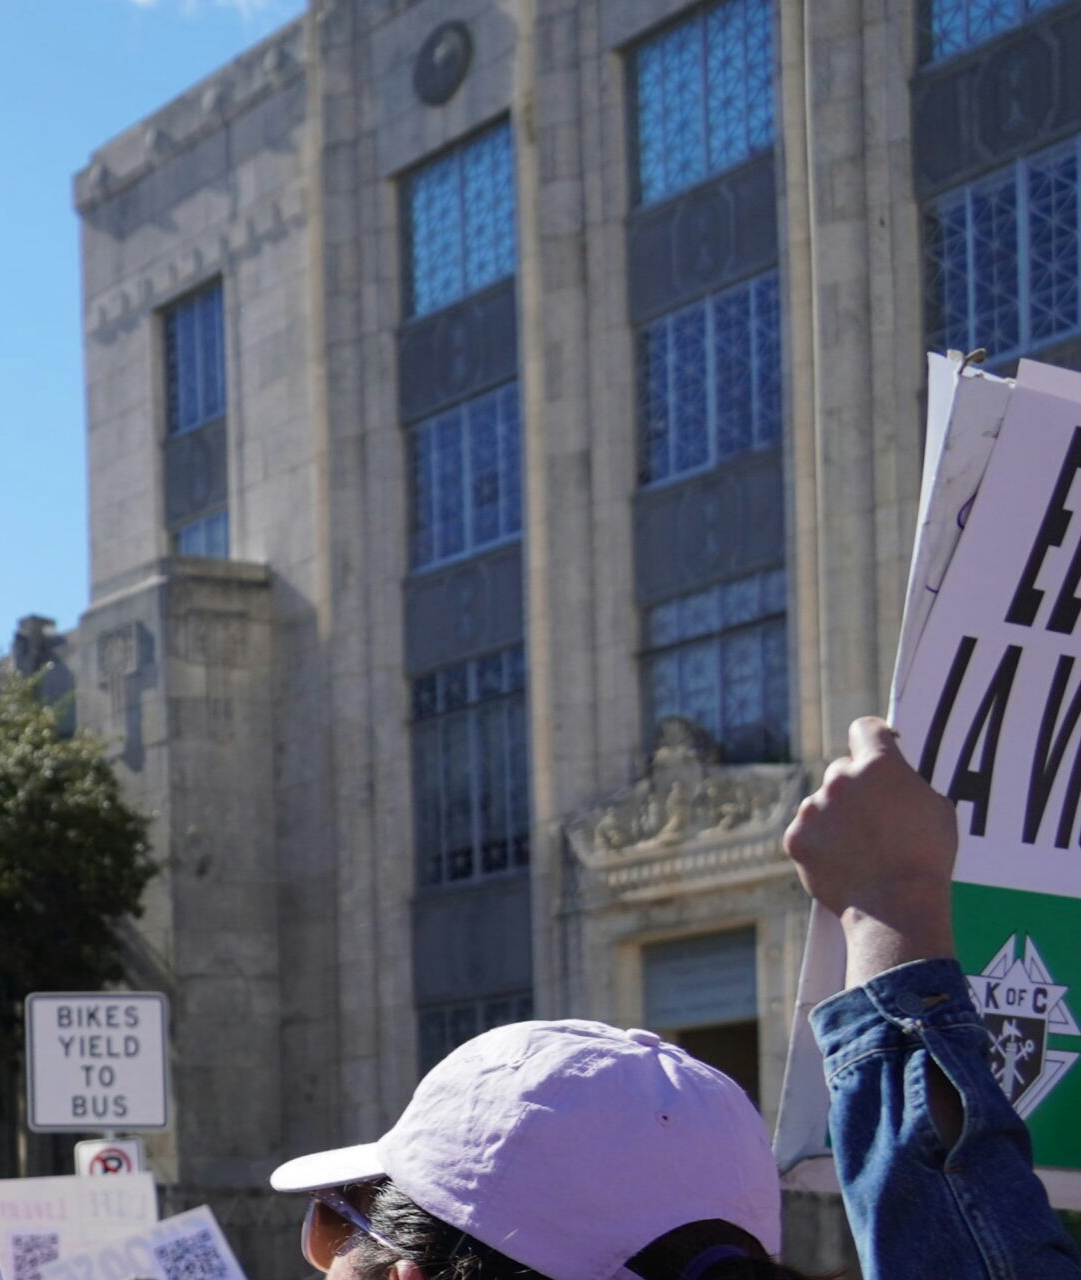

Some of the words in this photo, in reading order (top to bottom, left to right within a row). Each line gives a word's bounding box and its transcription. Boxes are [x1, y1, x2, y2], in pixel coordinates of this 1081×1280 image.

[984, 981, 1001, 1011] K
[1032, 987, 1049, 1015] C
[57, 1005, 139, 1029] BIKES
[58, 1035, 140, 1058] YIELD
[81, 1065, 115, 1088] TO
[72, 1095, 128, 1119] BUS
